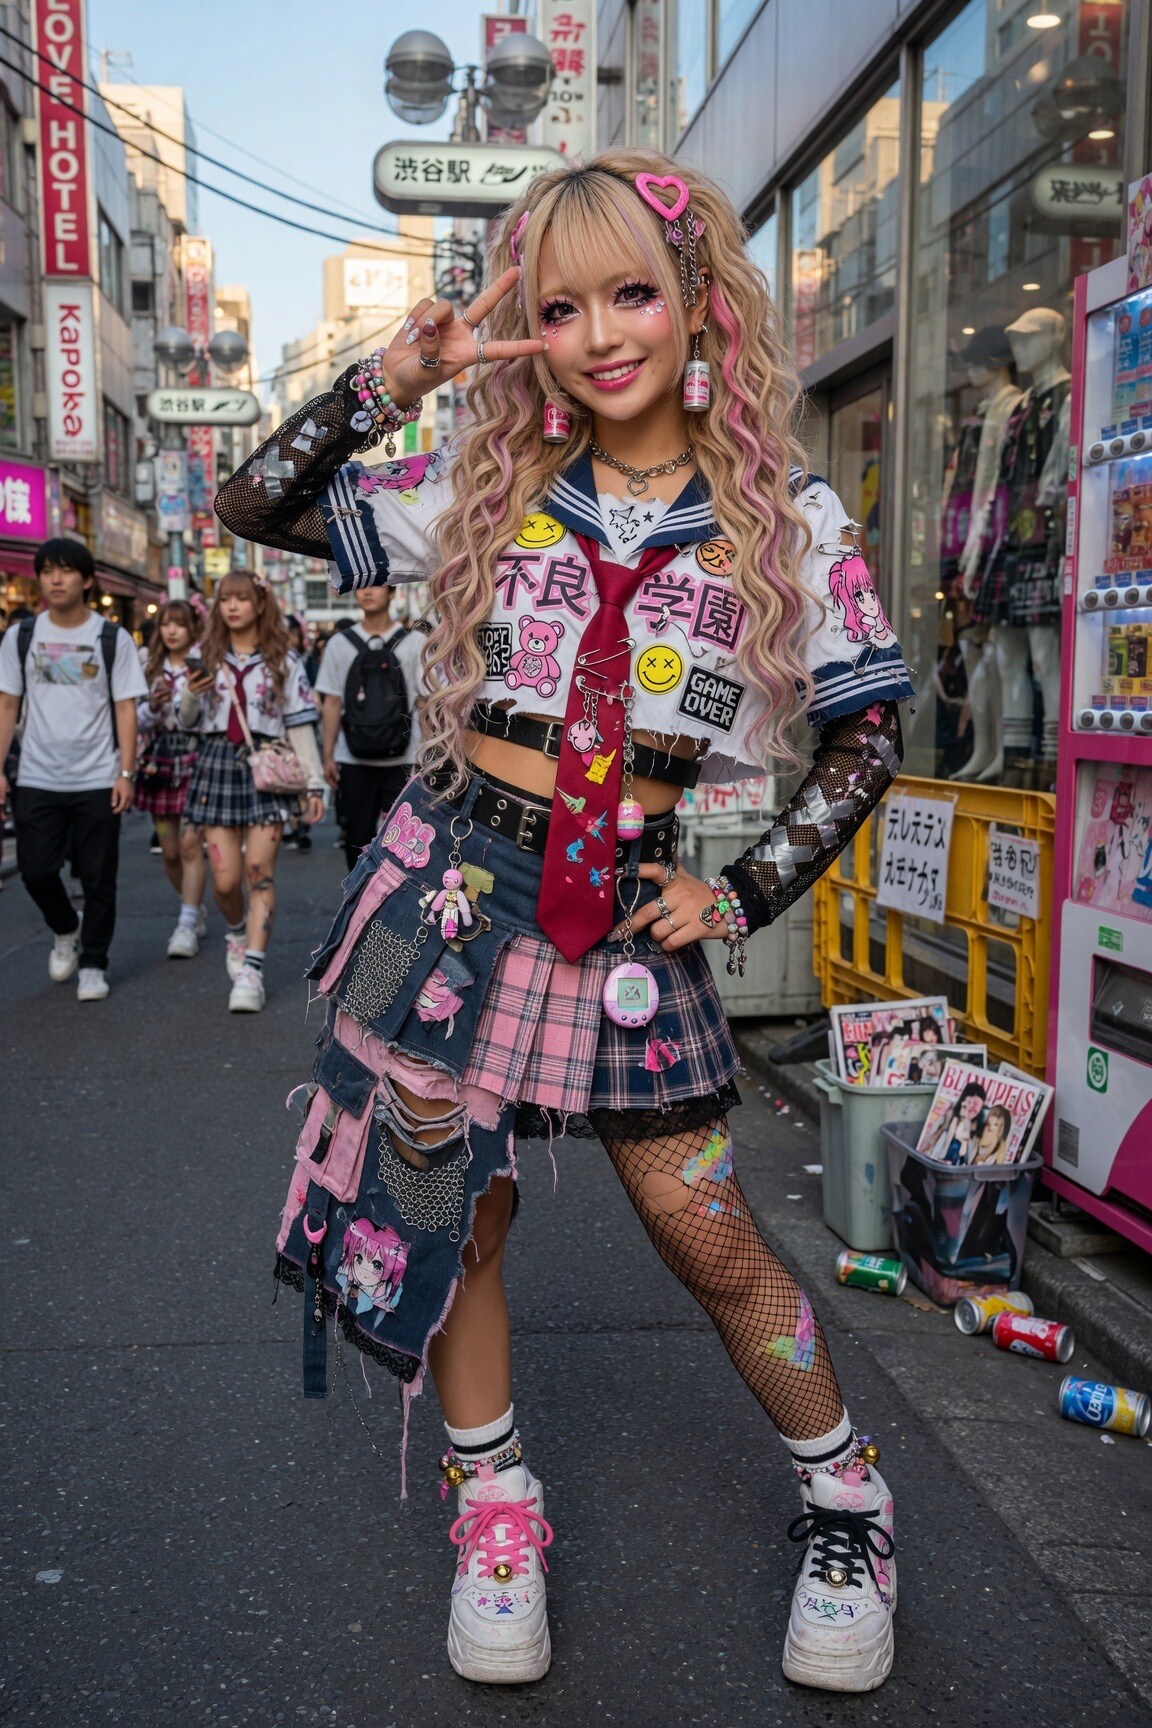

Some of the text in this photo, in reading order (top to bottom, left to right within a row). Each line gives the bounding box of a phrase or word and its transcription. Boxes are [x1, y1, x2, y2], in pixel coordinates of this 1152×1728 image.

[394, 156, 471, 184] 渋谷駅
[48, 120, 79, 271] HOTEL
[495, 555, 745, 650] 不良 学園
[690, 672, 740, 707] GAME
[683, 692, 734, 727] OVER
